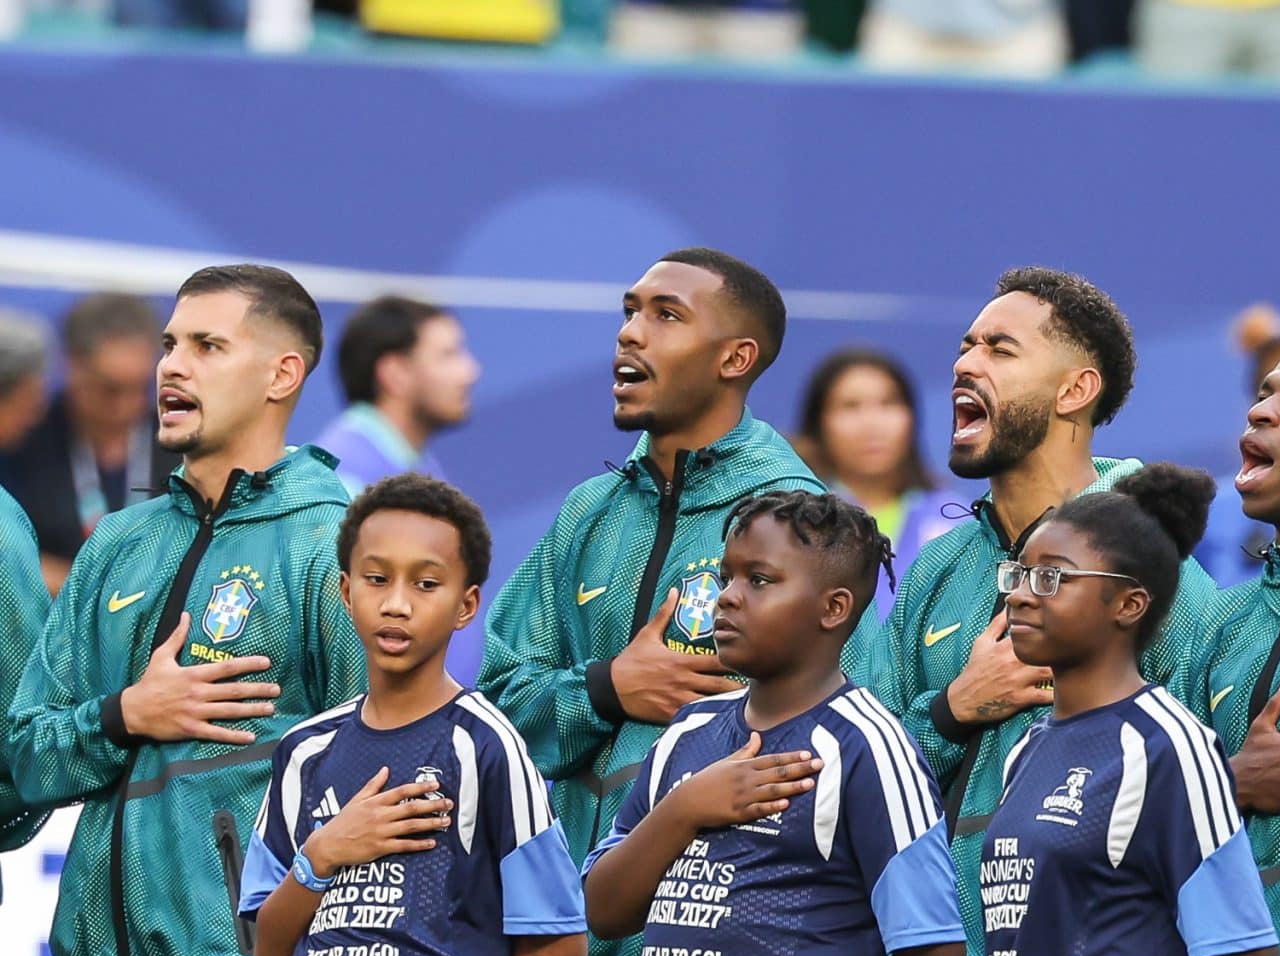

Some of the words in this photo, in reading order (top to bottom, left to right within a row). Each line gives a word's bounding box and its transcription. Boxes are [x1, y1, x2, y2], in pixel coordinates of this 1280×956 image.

[692, 598, 709, 608] CBF
[684, 839, 710, 858] IFA
[994, 838, 1018, 857] FIFA
[330, 862, 405, 888] MEN'S
[665, 859, 736, 886] MEN'S
[315, 886, 359, 912] ORLD
[362, 885, 404, 904] CUP
[655, 881, 688, 899] ORLD
[690, 883, 729, 902] CUP
[350, 905, 400, 929] 2027
[647, 899, 679, 924] RASIL
[679, 902, 725, 929] 2027
